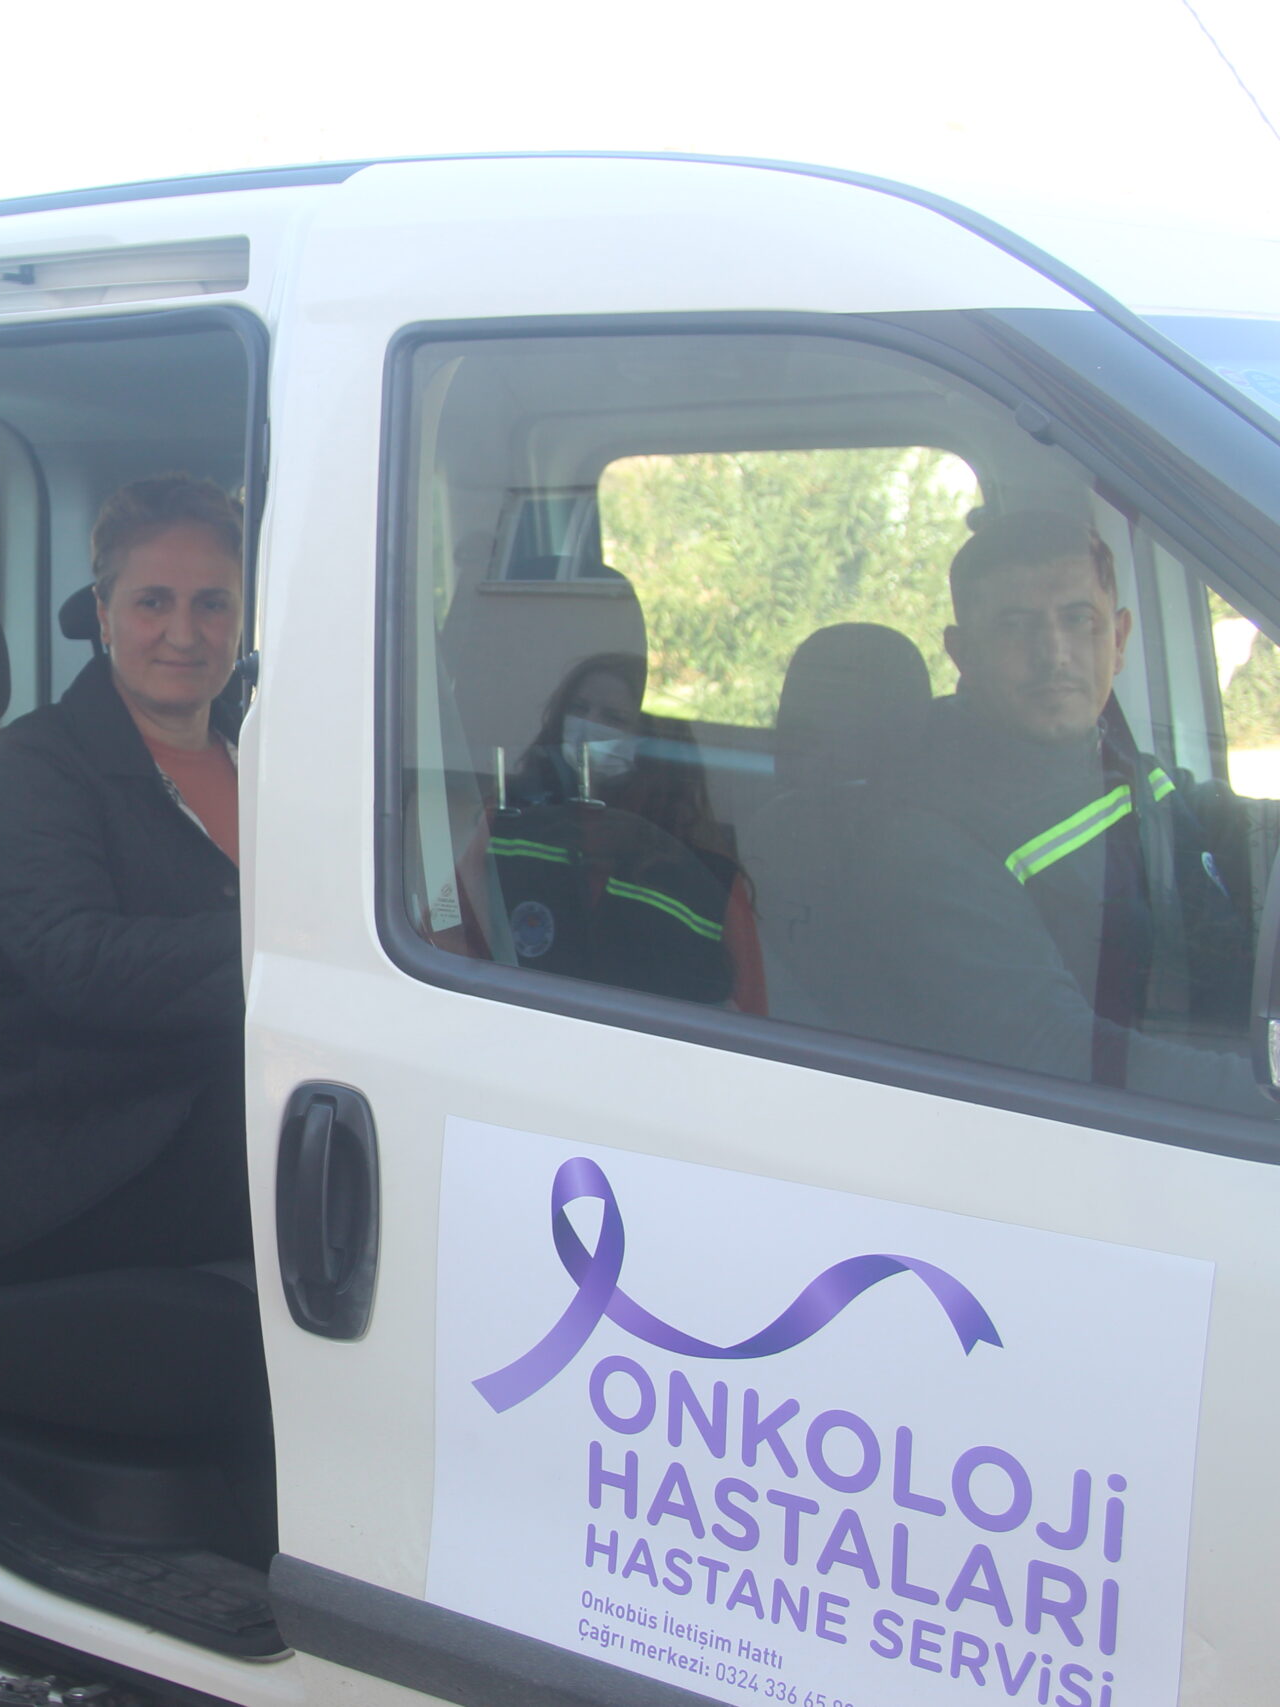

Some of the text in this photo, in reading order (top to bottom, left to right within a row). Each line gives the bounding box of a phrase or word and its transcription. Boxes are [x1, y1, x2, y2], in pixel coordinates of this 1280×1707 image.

[584, 1523, 850, 1645] HASTANE
[587, 1440, 1120, 1657] HASTALARI
[577, 1617, 827, 1707] Çağrı merkezi: 0324 336 65
[581, 1589, 784, 1669] Onkobüs İletişim Hattı
